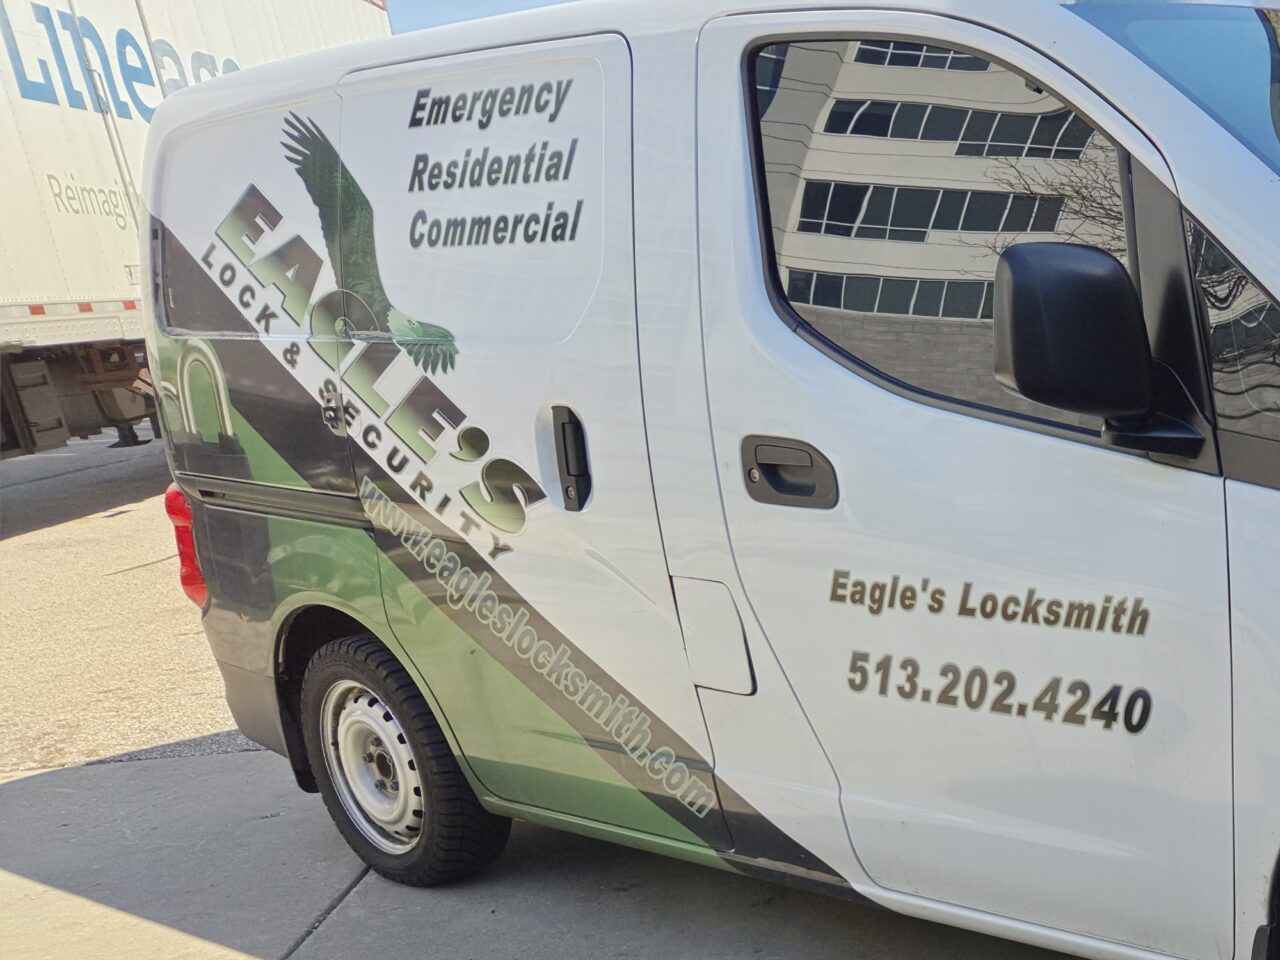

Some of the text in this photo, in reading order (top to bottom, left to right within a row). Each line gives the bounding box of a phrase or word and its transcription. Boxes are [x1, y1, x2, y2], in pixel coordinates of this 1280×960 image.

[0, 0, 240, 124] Linea
[408, 78, 574, 130] Emergency
[408, 138, 579, 193] Residential
[409, 199, 584, 249] Commercial
[214, 182, 548, 535] EAGLE'S
[200, 243, 514, 562] LOCK & SECURITY
[830, 569, 1150, 637] Eagle's Locksmith
[361, 475, 720, 819] www.eagleslocksmith.com
[848, 650, 1154, 735] 513.202.4240
